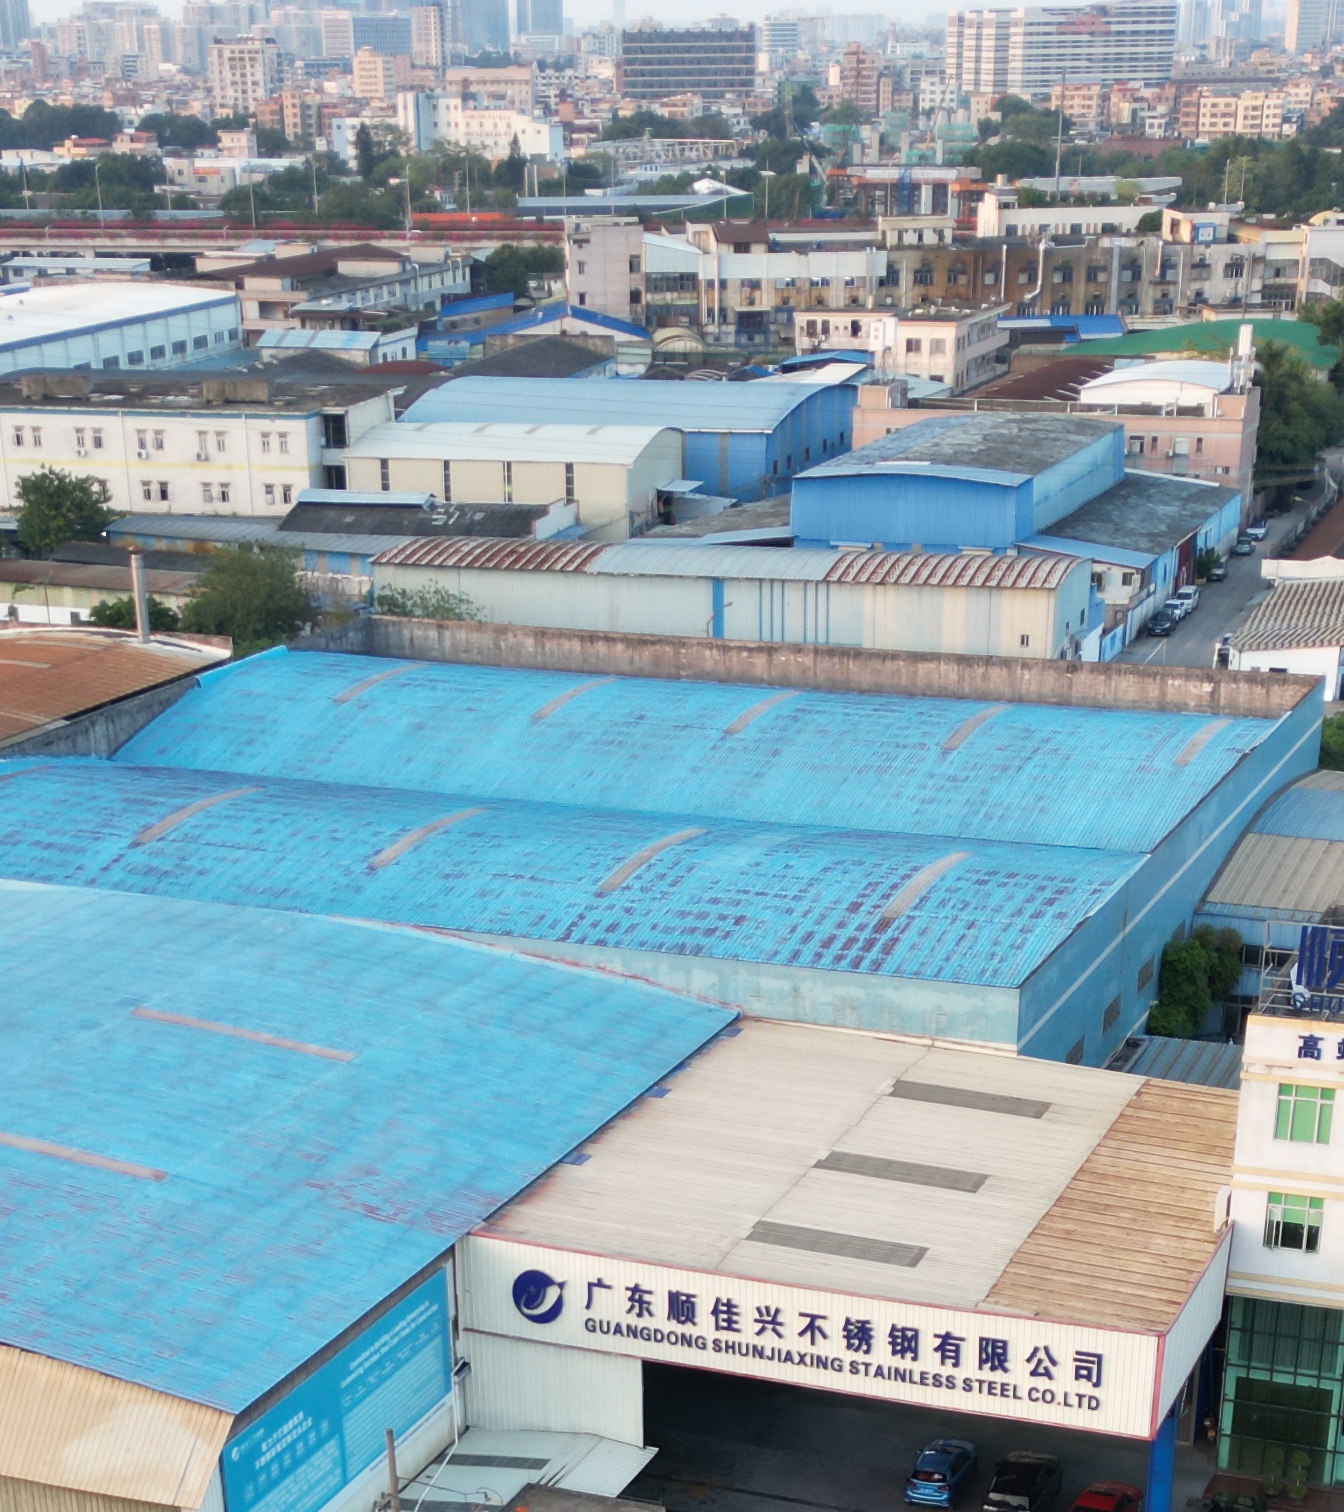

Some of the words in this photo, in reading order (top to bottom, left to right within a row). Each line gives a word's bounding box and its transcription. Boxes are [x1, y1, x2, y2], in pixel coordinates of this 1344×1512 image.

[584, 1277, 1104, 1389] 广东顺佳兴不锈钢有限公司
[584, 1317, 706, 1351] GUANGDONG
[712, 1338, 843, 1373] SHUNJIAXING
[849, 1359, 957, 1390] STAINLESS
[962, 1377, 1022, 1401] STEEL
[1027, 1386, 1101, 1412] CO.LTD
